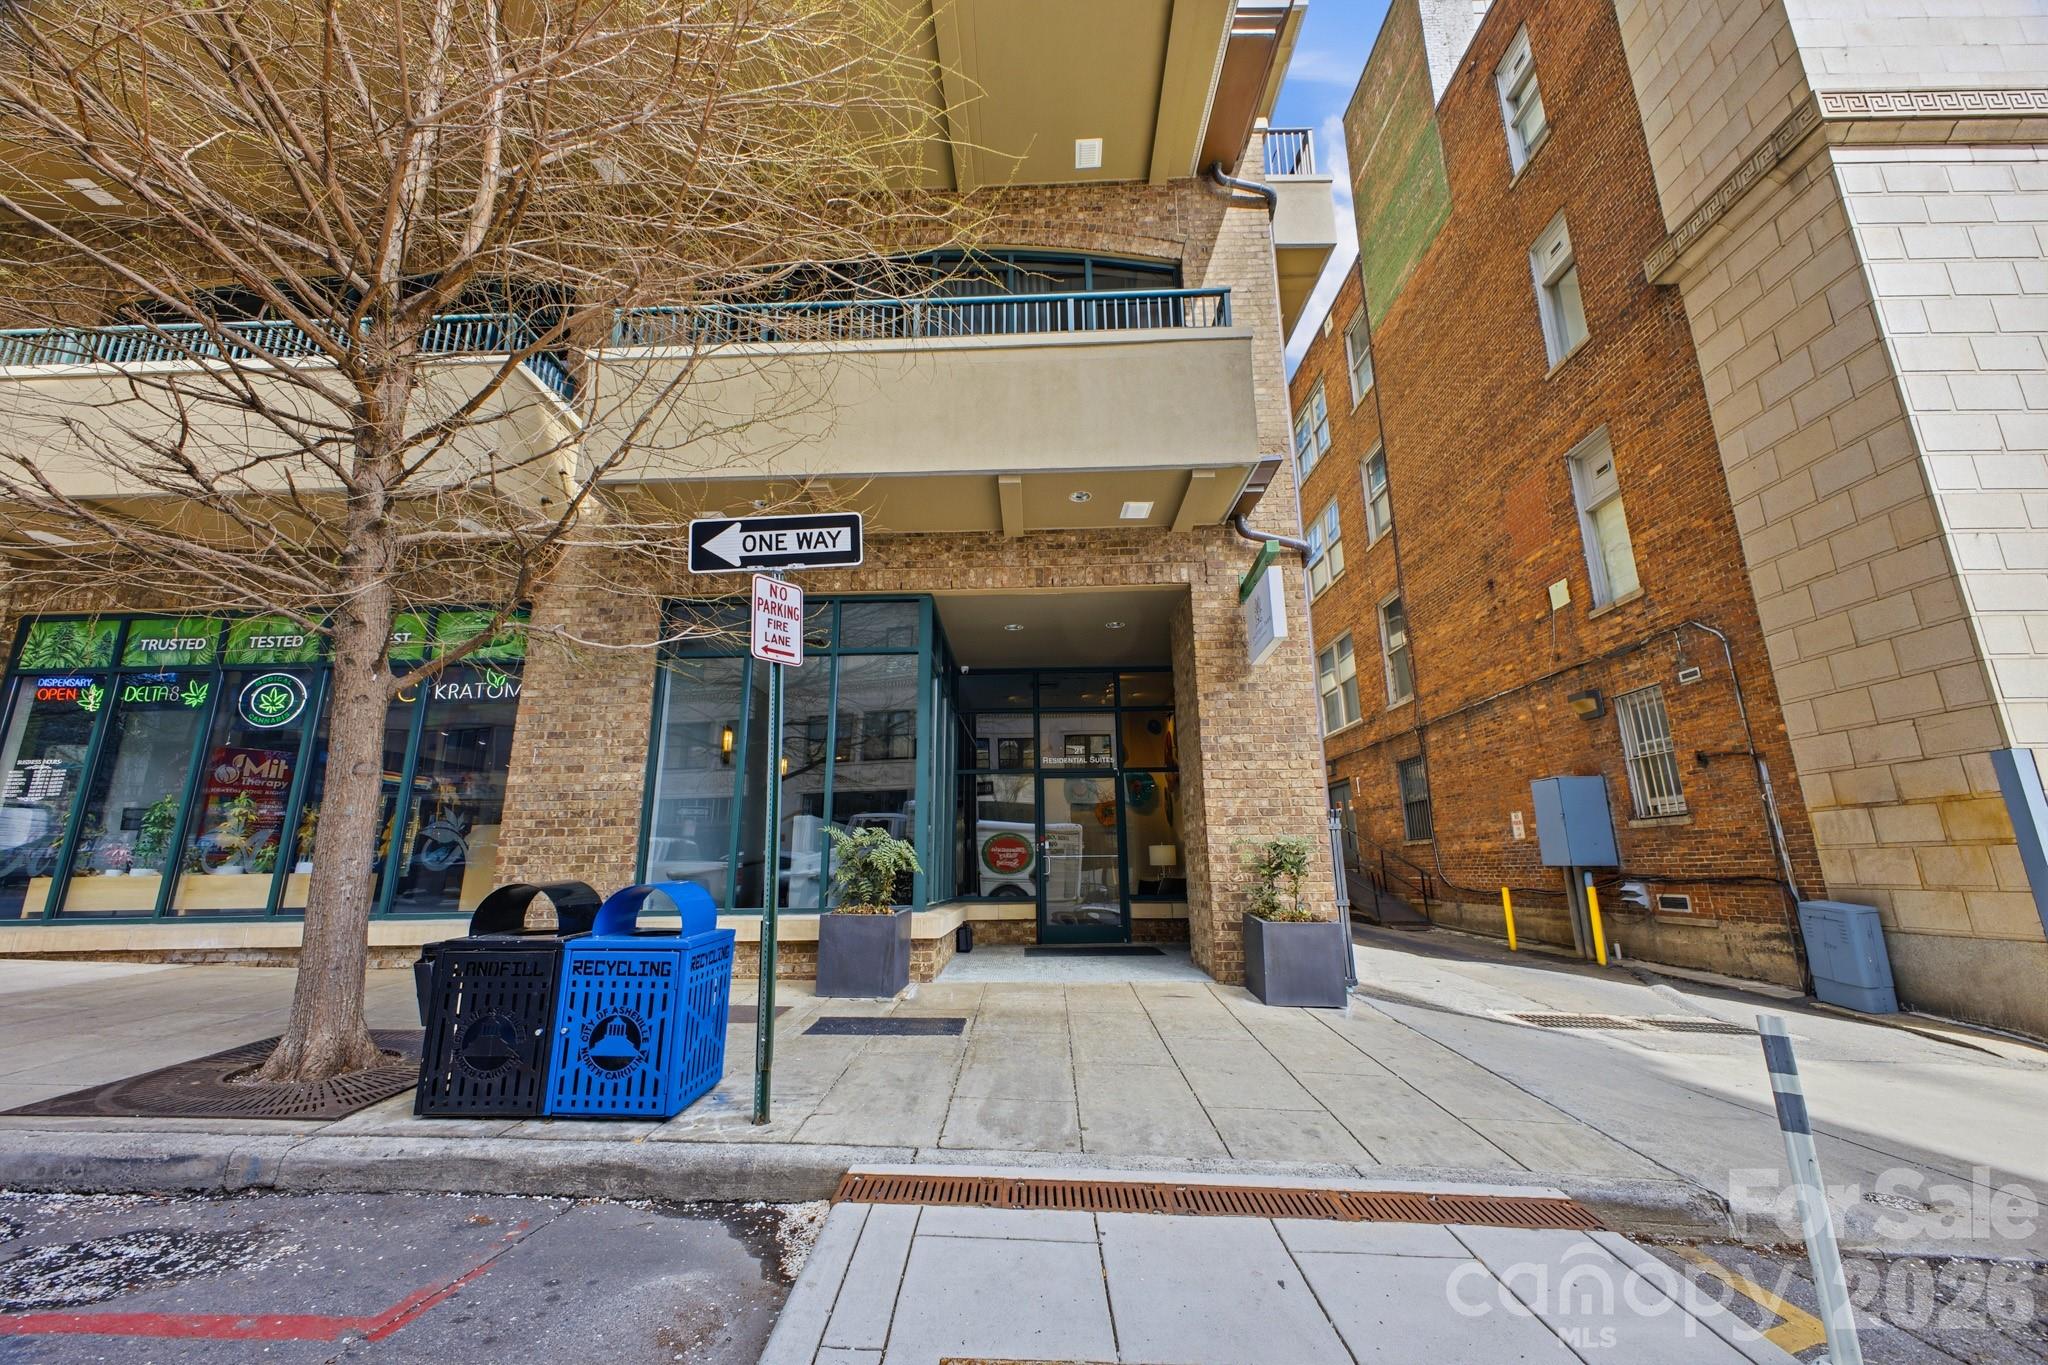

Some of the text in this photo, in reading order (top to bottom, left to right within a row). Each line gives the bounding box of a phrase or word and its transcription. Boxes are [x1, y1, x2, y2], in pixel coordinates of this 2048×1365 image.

[742, 530, 841, 552] ONE WAY
[770, 584, 787, 600] NO
[757, 597, 799, 621] PARKING
[768, 618, 788, 632] FIRE
[141, 638, 206, 650] TRUSTED
[250, 635, 303, 648] TESTED
[765, 632, 791, 647] LANE
[37, 678, 93, 687] DISPENSARY
[254, 675, 293, 687] MEDICAL
[37, 688, 77, 700] OPEN
[124, 686, 180, 702] DELTA 8
[248, 712, 290, 724] CANNABIS
[243, 756, 288, 779] Mit
[241, 777, 288, 789] Therapy
[690, 946, 730, 971] RECYCLING
[572, 960, 672, 976] RECYCLING
[581, 1006, 649, 1043] CITY OF ASHEVILLE
[580, 1047, 648, 1081] NORTH CAROLINA
